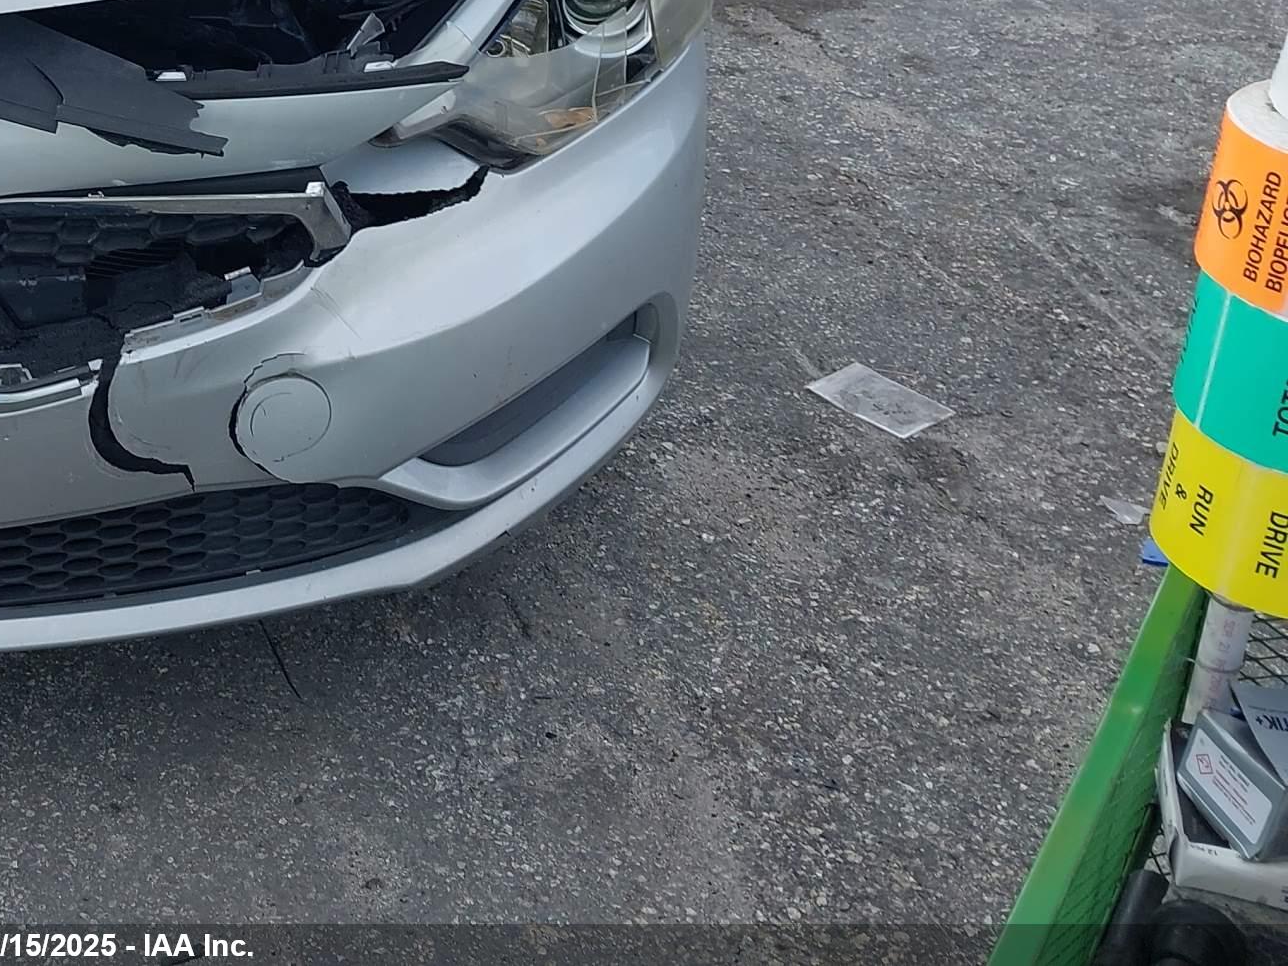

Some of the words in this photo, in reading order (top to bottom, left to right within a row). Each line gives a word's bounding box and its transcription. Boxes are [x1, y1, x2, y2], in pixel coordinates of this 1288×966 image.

[1243, 172, 1282, 283] BIOHAZARD
[1160, 442, 1179, 510] DRIVE
[1175, 483, 1188, 500] &
[1189, 485, 1214, 536] RUN
[1255, 510, 1288, 579] DRIVE
